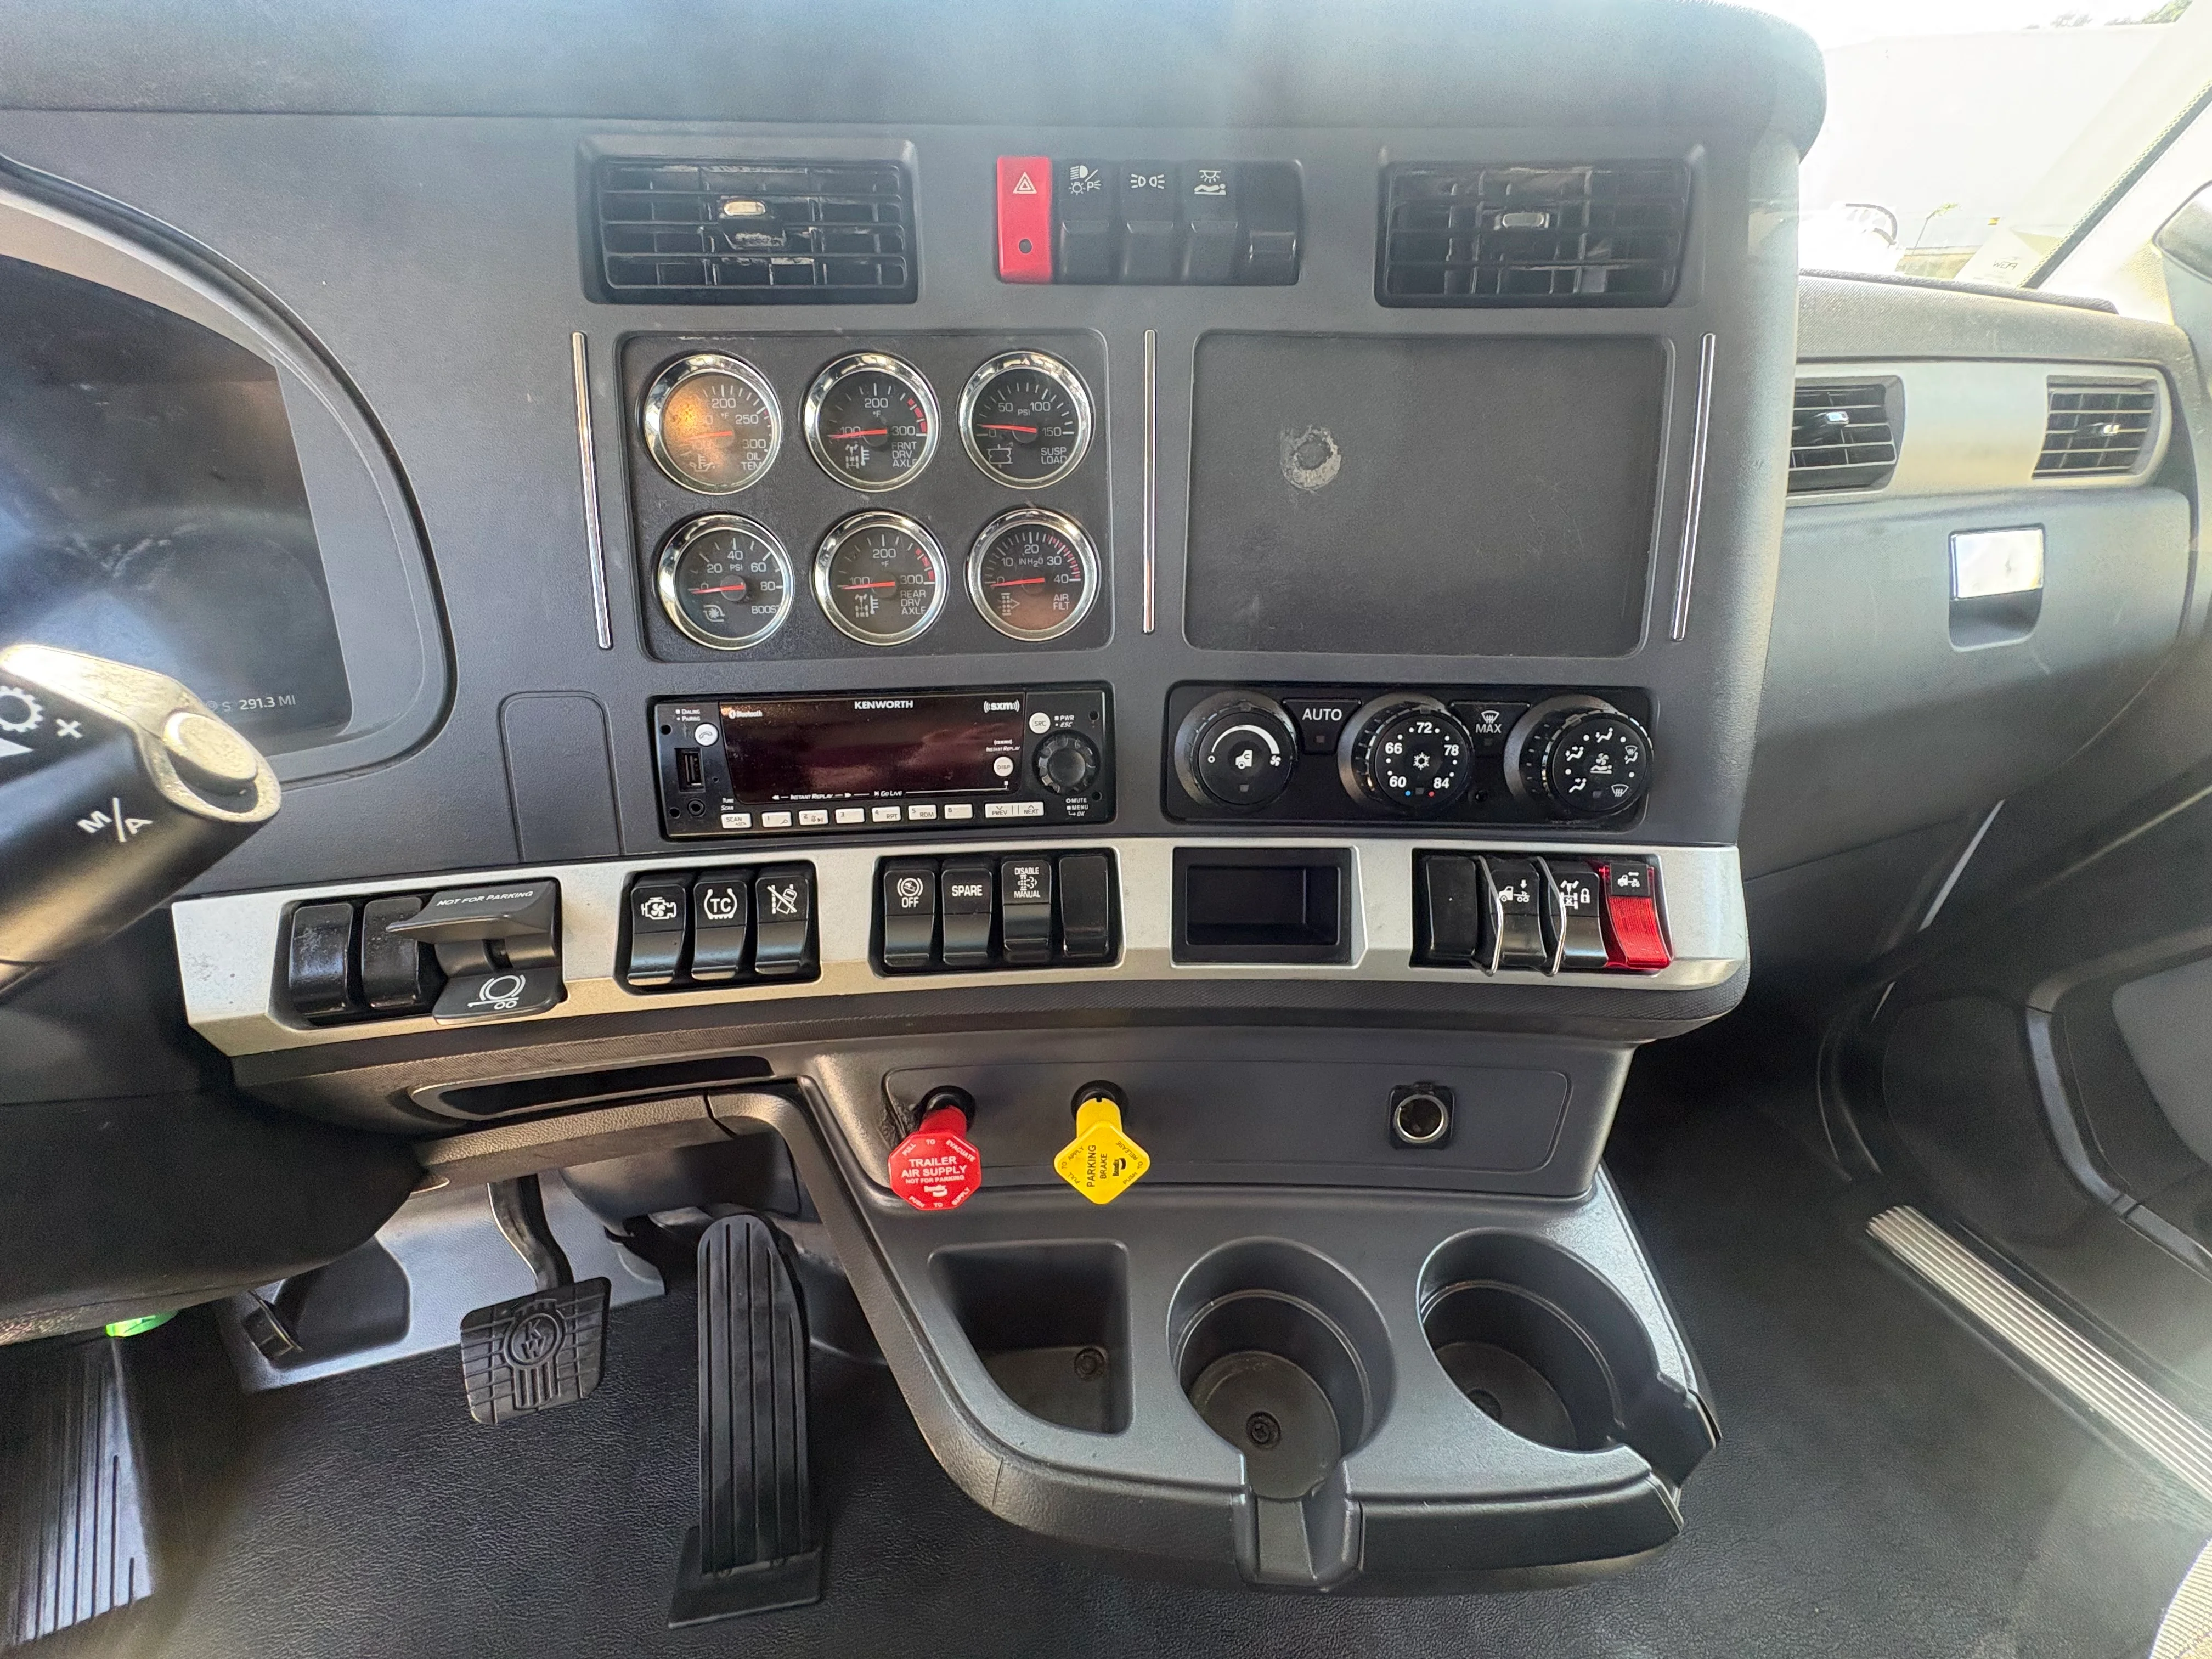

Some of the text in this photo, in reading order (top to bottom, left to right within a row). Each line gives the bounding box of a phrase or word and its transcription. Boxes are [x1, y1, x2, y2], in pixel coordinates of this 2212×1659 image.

[712, 398, 736, 408] 200
[864, 398, 888, 408] 200
[998, 403, 1013, 412] 50
[1030, 402, 1051, 411] 100
[735, 414, 759, 425] 250
[892, 426, 916, 436] 300
[1042, 427, 1062, 437] 150
[743, 439, 766, 449] 300
[892, 441, 917, 449] FRNT
[892, 450, 912, 459] DRV
[1041, 447, 1066, 455] SUSP
[746, 452, 761, 461] OIL
[1041, 456, 1066, 464] LOAD
[873, 549, 896, 558] 200
[1024, 544, 1039, 554] 20
[727, 551, 743, 560] 40
[1001, 557, 1013, 567] 10
[1047, 556, 1062, 566] 30
[707, 563, 723, 573] 20
[751, 562, 766, 572] 60
[900, 575, 923, 584] 300
[1053, 574, 1069, 584] 40
[760, 581, 776, 590] 80
[900, 590, 926, 598] REAR
[901, 606, 927, 615] AXLE
[1053, 601, 1070, 610] FILT
[222, 695, 296, 712] S 291.3 MI
[854, 700, 913, 709] KENWORTH
[1302, 709, 1342, 721] AUTO
[1416, 722, 1432, 733] 72
[1475, 724, 1502, 733] MAX
[1385, 742, 1403, 754] 66
[1443, 744, 1459, 756] 78
[1389, 776, 1407, 788] 60
[1433, 777, 1449, 789] 84
[77, 797, 153, 843] M/A
[952, 885, 983, 896] SPARE
[437, 898, 461, 906] NOT
[486, 891, 534, 901] PARKING
[901, 896, 919, 908] OFF
[710, 898, 731, 913] TC
[902, 1142, 917, 1156] PULL
[945, 1139, 976, 1162] EVACUATE
[1068, 1146, 1084, 1161] APPLY
[909, 1156, 957, 1167] TRAILER
[1086, 1144, 1097, 1187] PARKING
[1099, 1153, 1108, 1179] BRAKE
[1115, 1140, 1144, 1185] PUSH TO RELEASE
[901, 1165, 967, 1178] AIR SUPPLY
[935, 1174, 965, 1182] PARKING
[1068, 1171, 1080, 1184] PULL
[909, 1195, 926, 1208] PUSH
[951, 1187, 970, 1206] SUPPLY
